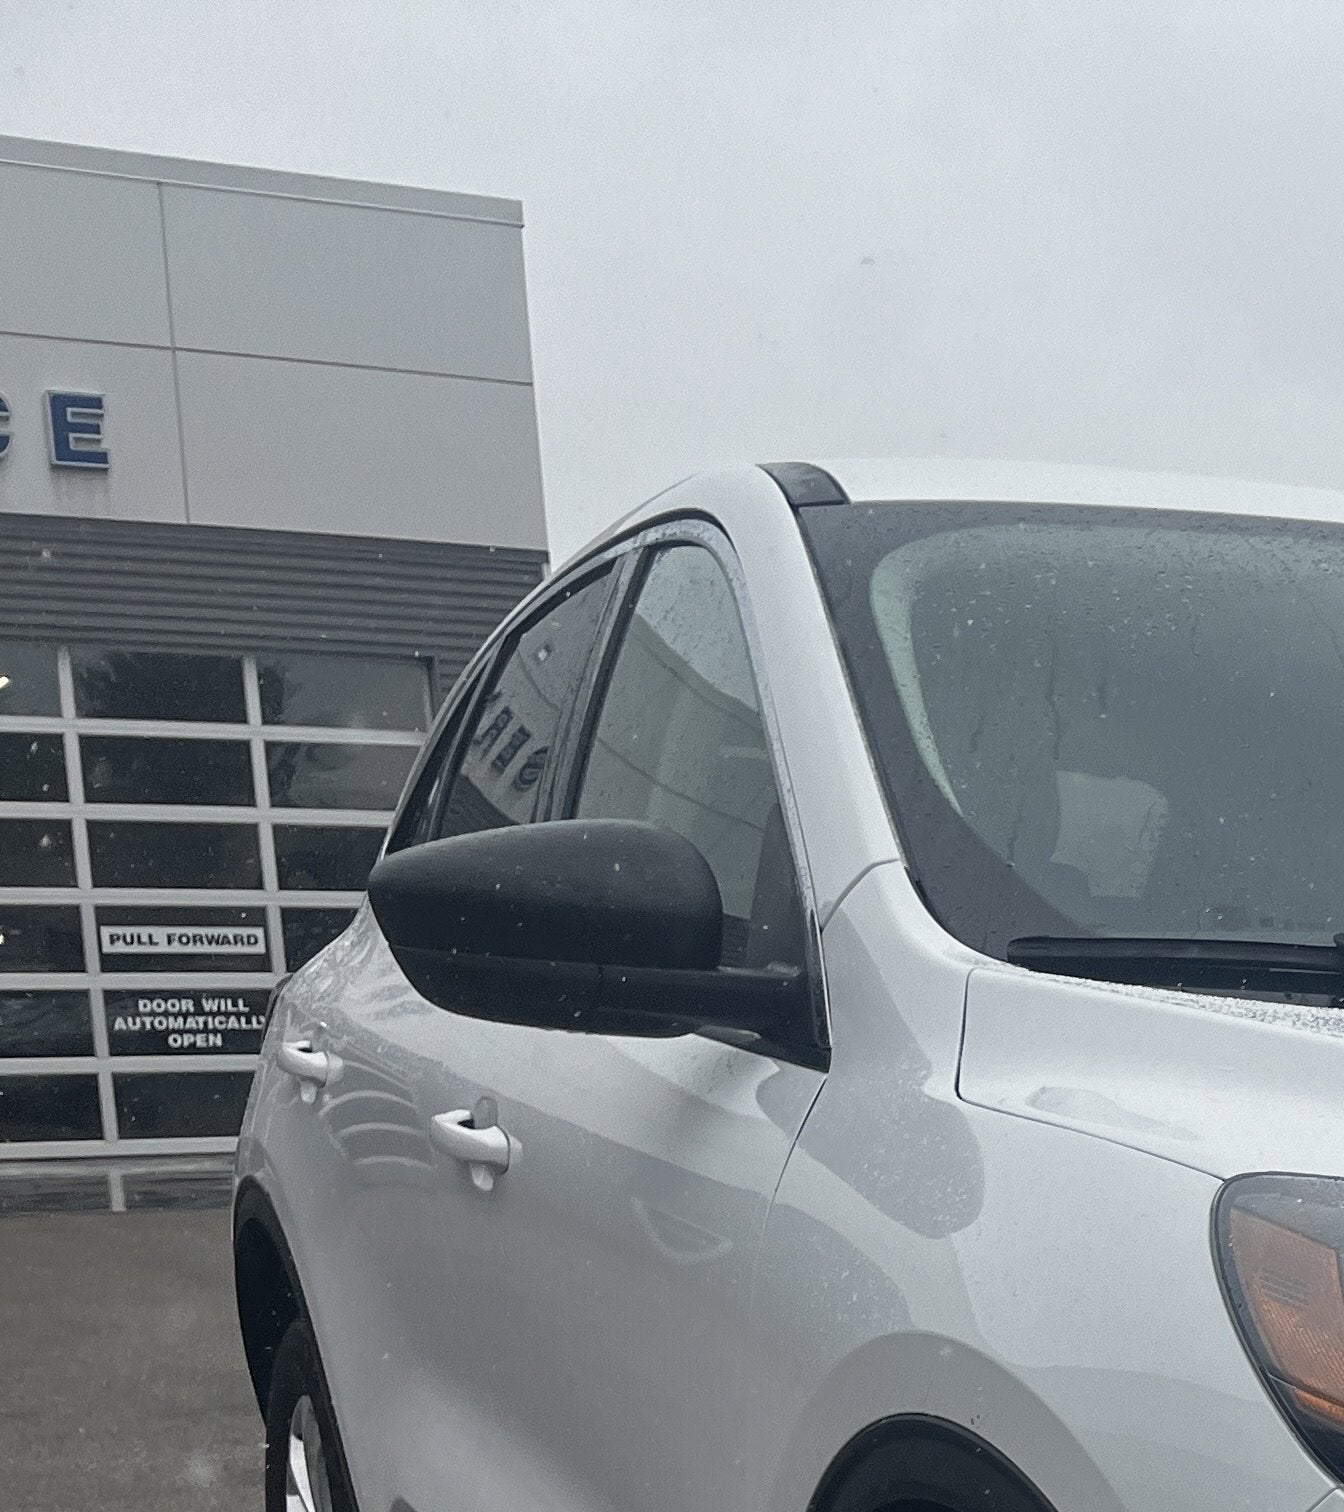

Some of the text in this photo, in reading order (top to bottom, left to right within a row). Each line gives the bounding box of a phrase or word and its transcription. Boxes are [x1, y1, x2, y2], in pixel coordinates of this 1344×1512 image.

[109, 932, 259, 947] PULL FORWARD
[137, 997, 250, 1014] DOOR WILL
[167, 1032, 223, 1049] OPEN
